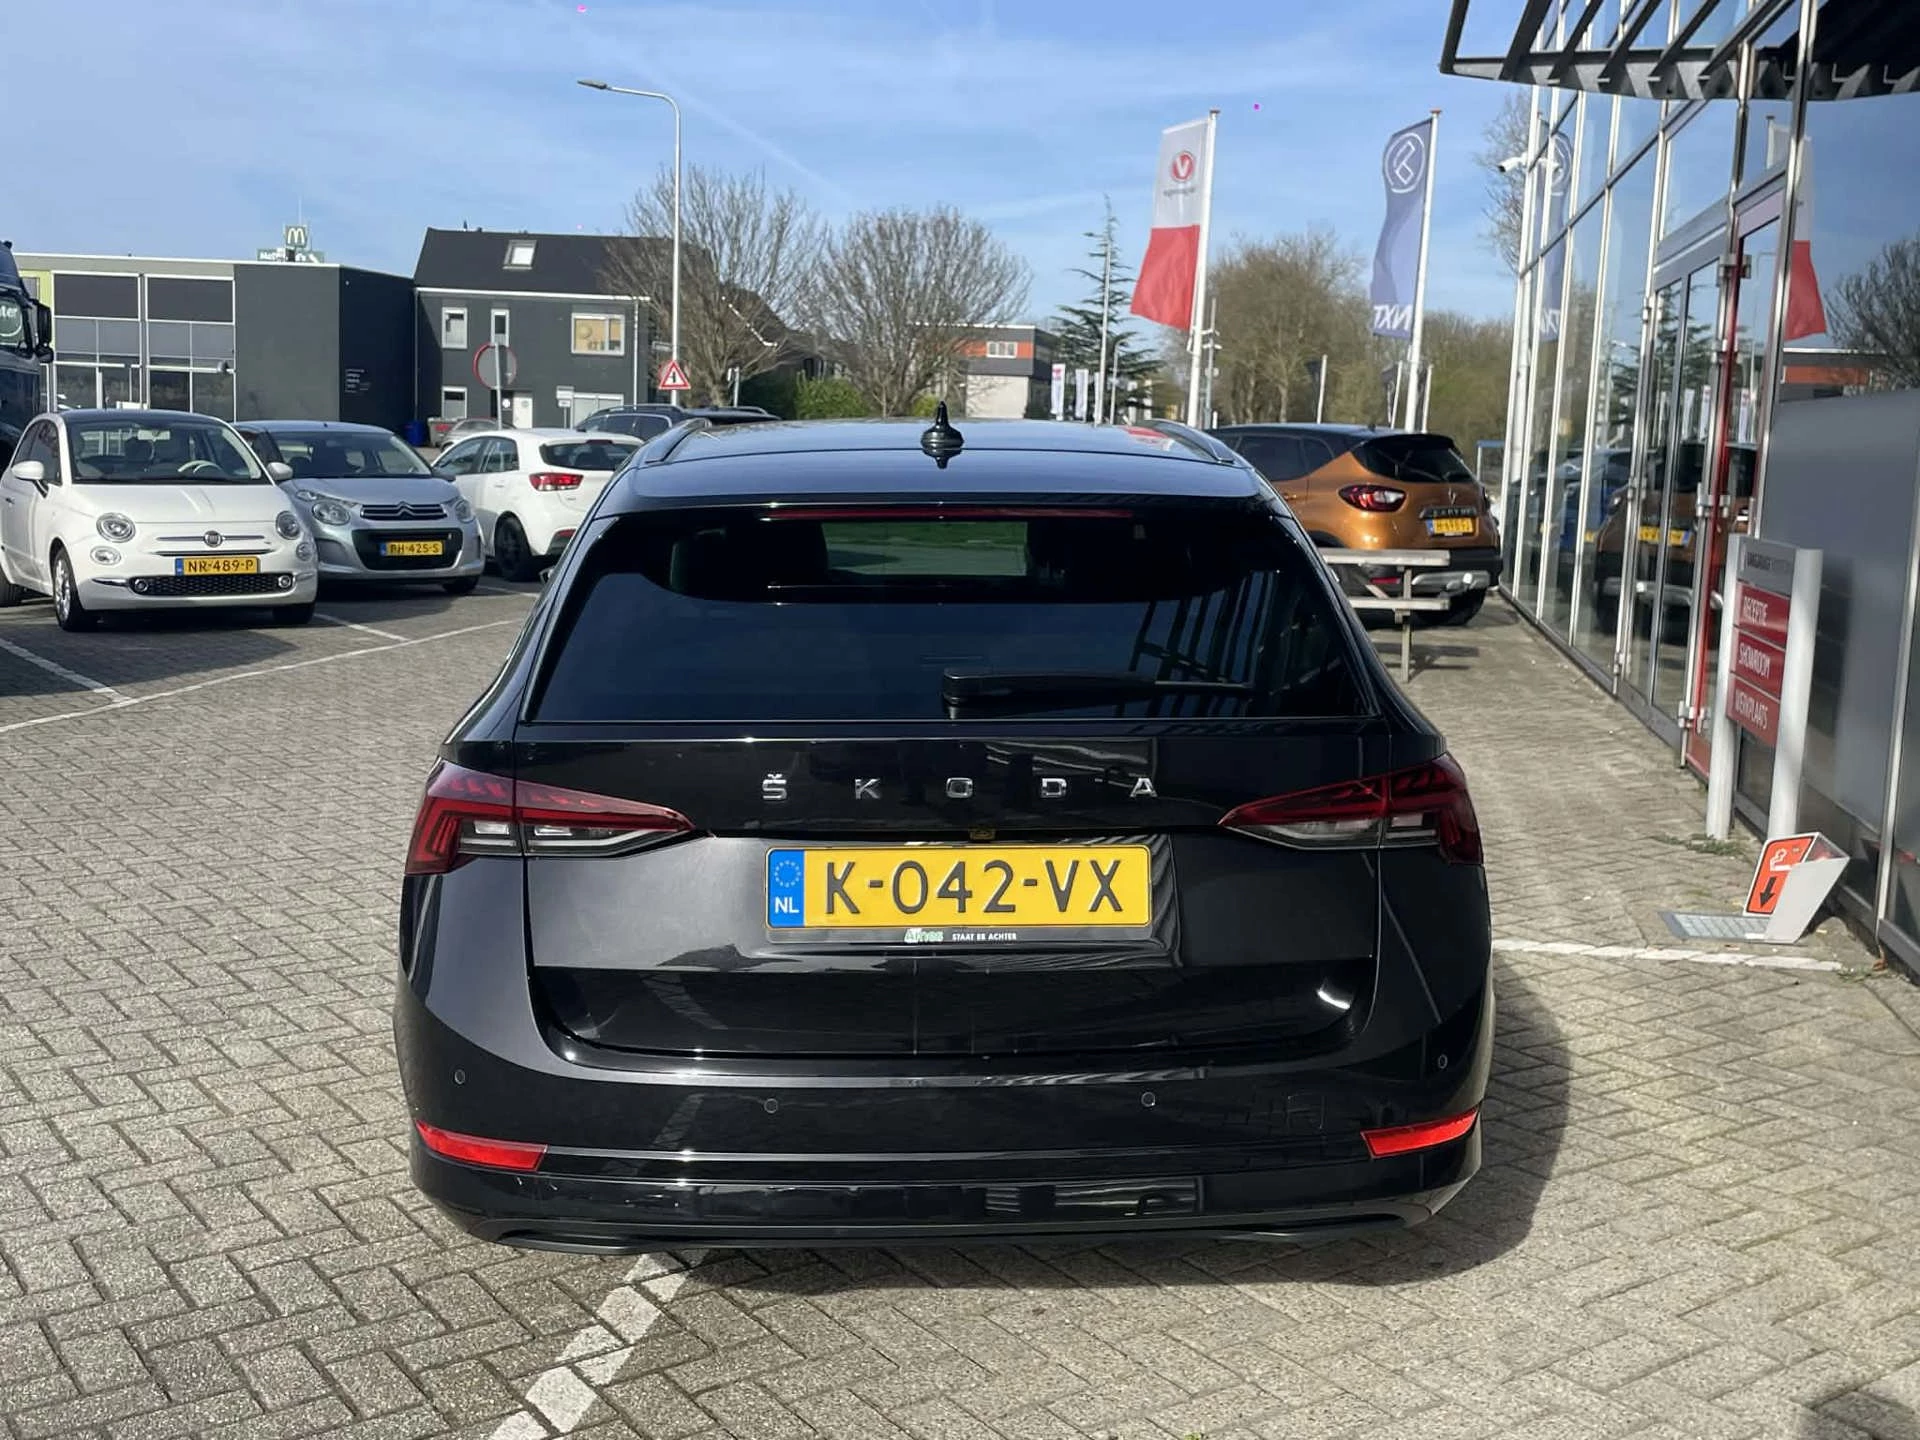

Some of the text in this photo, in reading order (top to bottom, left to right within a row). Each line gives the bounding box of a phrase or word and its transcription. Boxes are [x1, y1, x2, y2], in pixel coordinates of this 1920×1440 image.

[188, 559, 254, 573] NR-489-P
[1743, 595, 1768, 627] RECEPTIE
[1738, 642, 1770, 680] SHOWROOM
[1735, 689, 1769, 731] WERKPLAATS
[763, 774, 1158, 800] ŠKODA
[825, 860, 1123, 916] K-042-VX
[774, 896, 800, 914] NL
[952, 933, 974, 941] STAAT
[988, 932, 1017, 941] ACHTER
